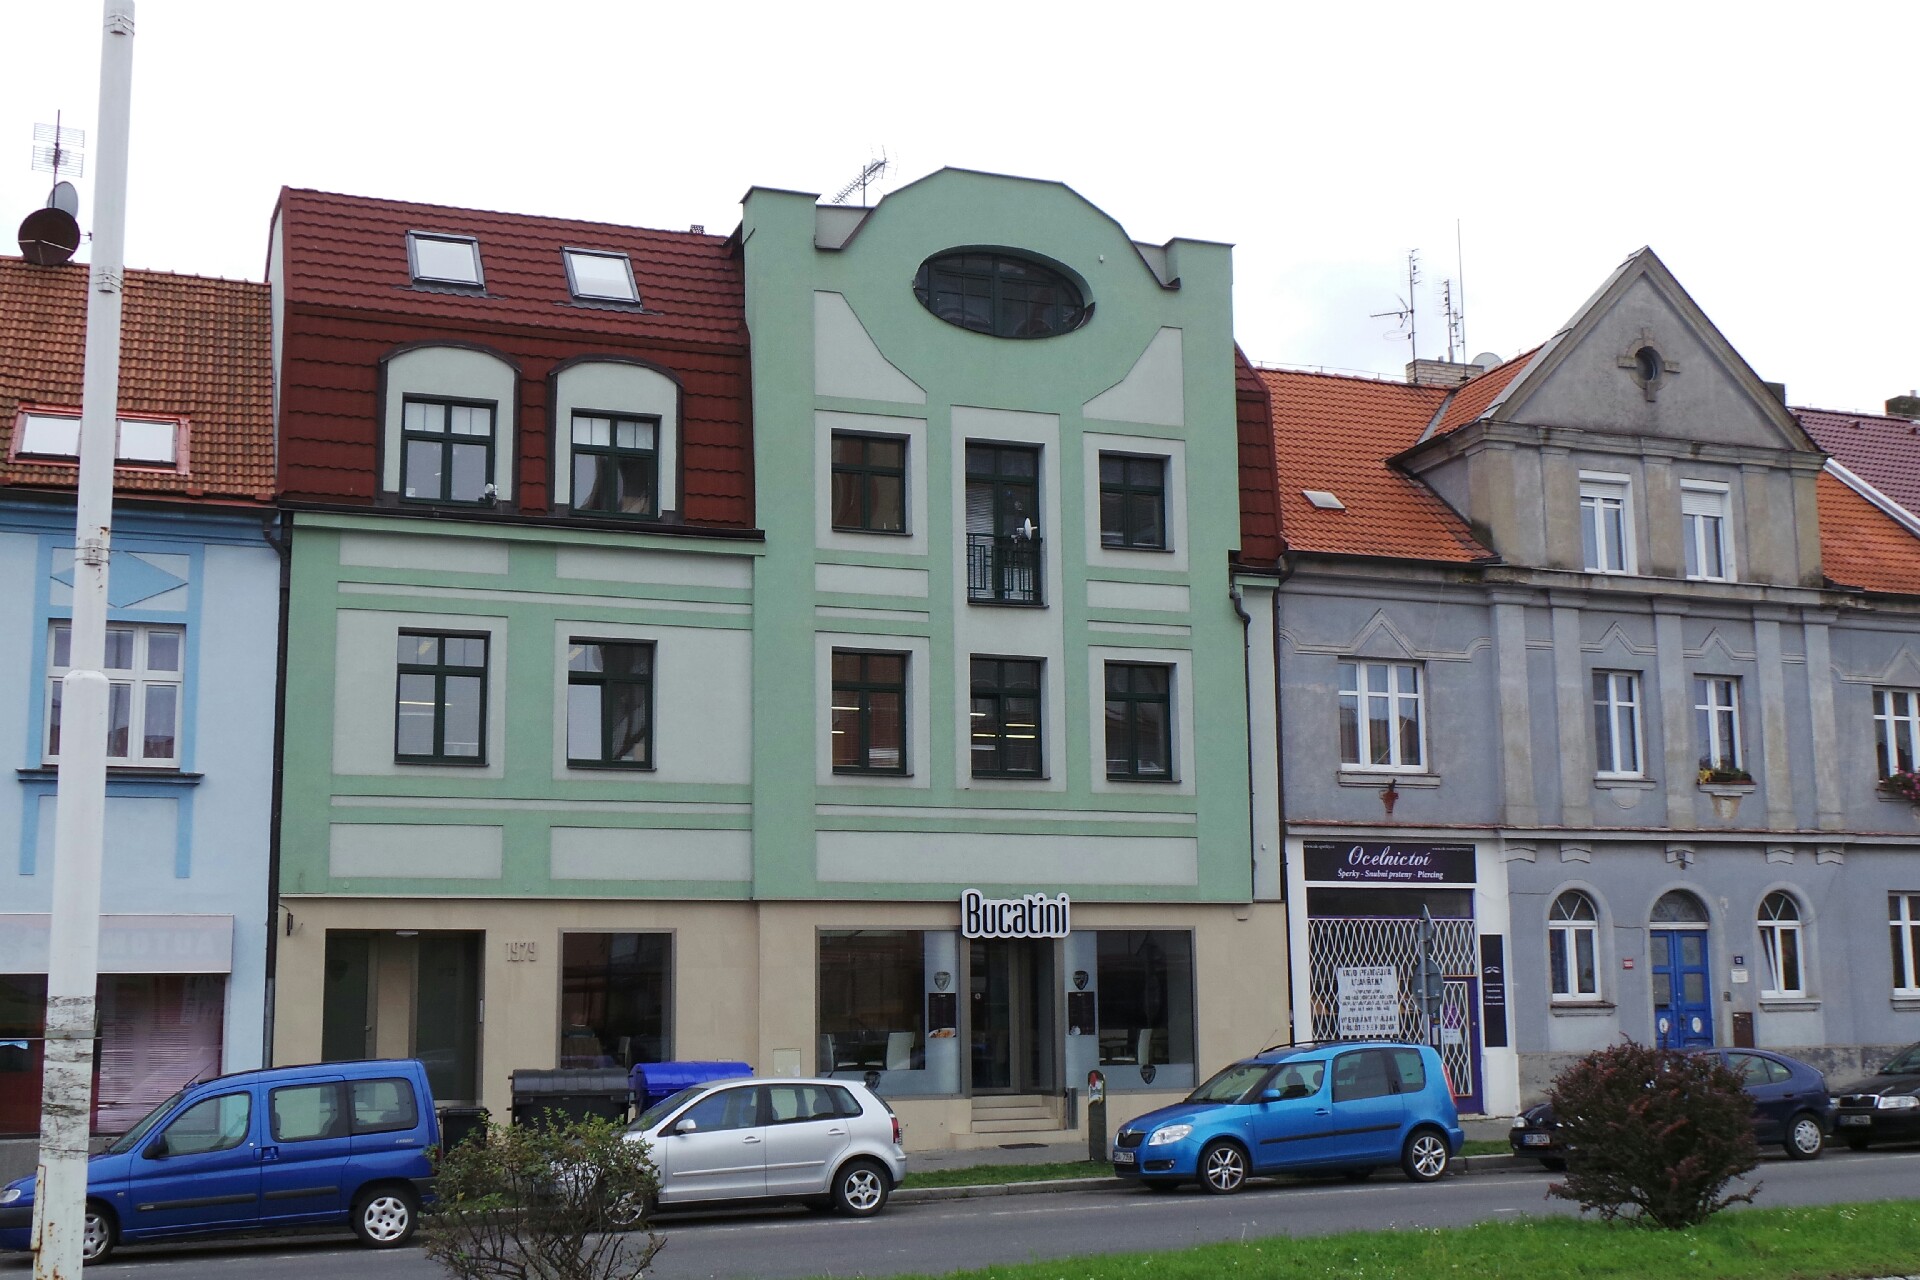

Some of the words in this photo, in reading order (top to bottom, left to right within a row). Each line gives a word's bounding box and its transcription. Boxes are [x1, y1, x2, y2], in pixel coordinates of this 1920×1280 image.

[1348, 845, 1432, 866] Ocelnictví
[1337, 867, 1360, 879] Šperky
[1365, 869, 1388, 878] Snubní
[1388, 870, 1412, 880] prsteny
[1417, 870, 1444, 880] Piercing
[966, 892, 1067, 934] Bucatini
[505, 941, 538, 962] 1979
